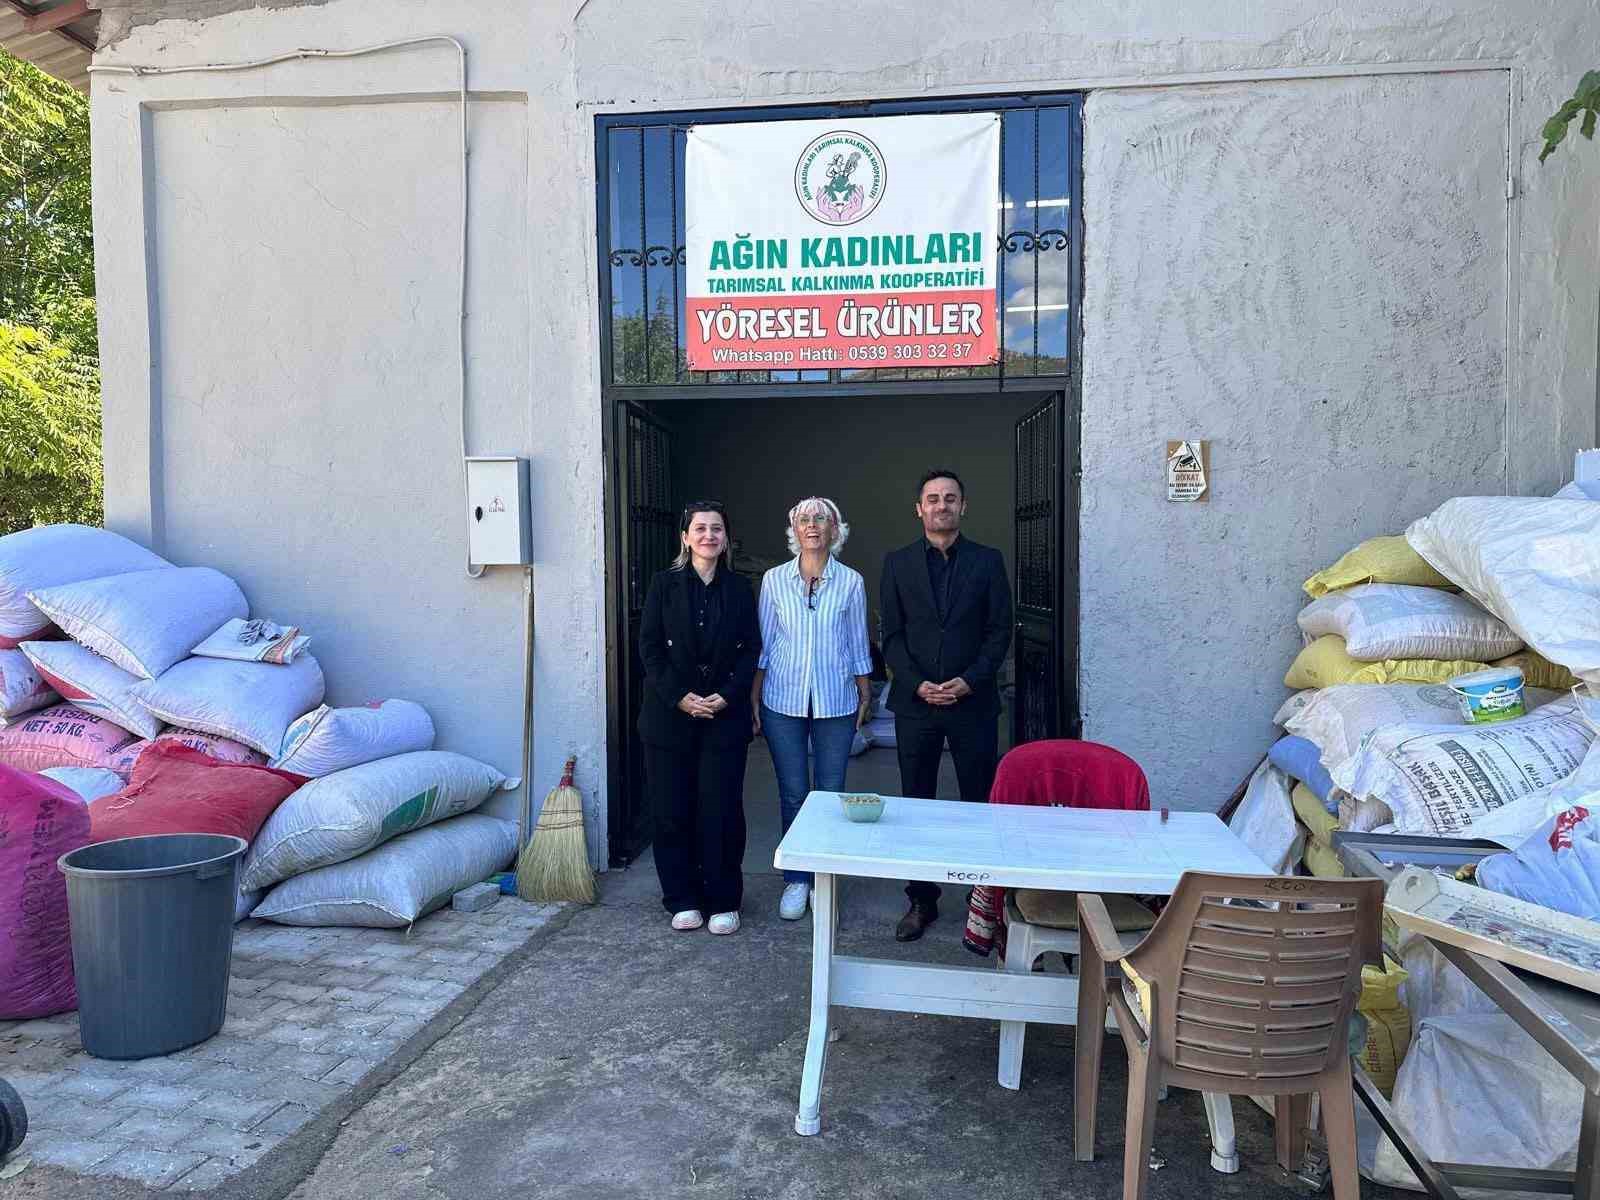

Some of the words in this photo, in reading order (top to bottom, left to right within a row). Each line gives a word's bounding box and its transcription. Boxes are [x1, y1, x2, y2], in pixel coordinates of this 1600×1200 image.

[709, 232, 788, 270] AĞIN
[800, 232, 982, 268] KADINLARI
[707, 277, 786, 293] TARIMSAL
[792, 274, 875, 291] KALKINMA
[880, 267, 984, 289] KOOPERATİFİ
[696, 302, 828, 344] YÖRESEL
[836, 298, 984, 341] ÜRÜNLER
[712, 347, 794, 365] Whatsapp
[848, 345, 888, 360] 0539
[893, 344, 922, 359] 303
[927, 343, 948, 358] 32
[952, 343, 973, 357] 37
[52, 721, 69, 734] 50
[1408, 761, 1443, 800] BAŞAK
[1448, 768, 1480, 809] KOMPOZE
[947, 870, 991, 881] KOOP
